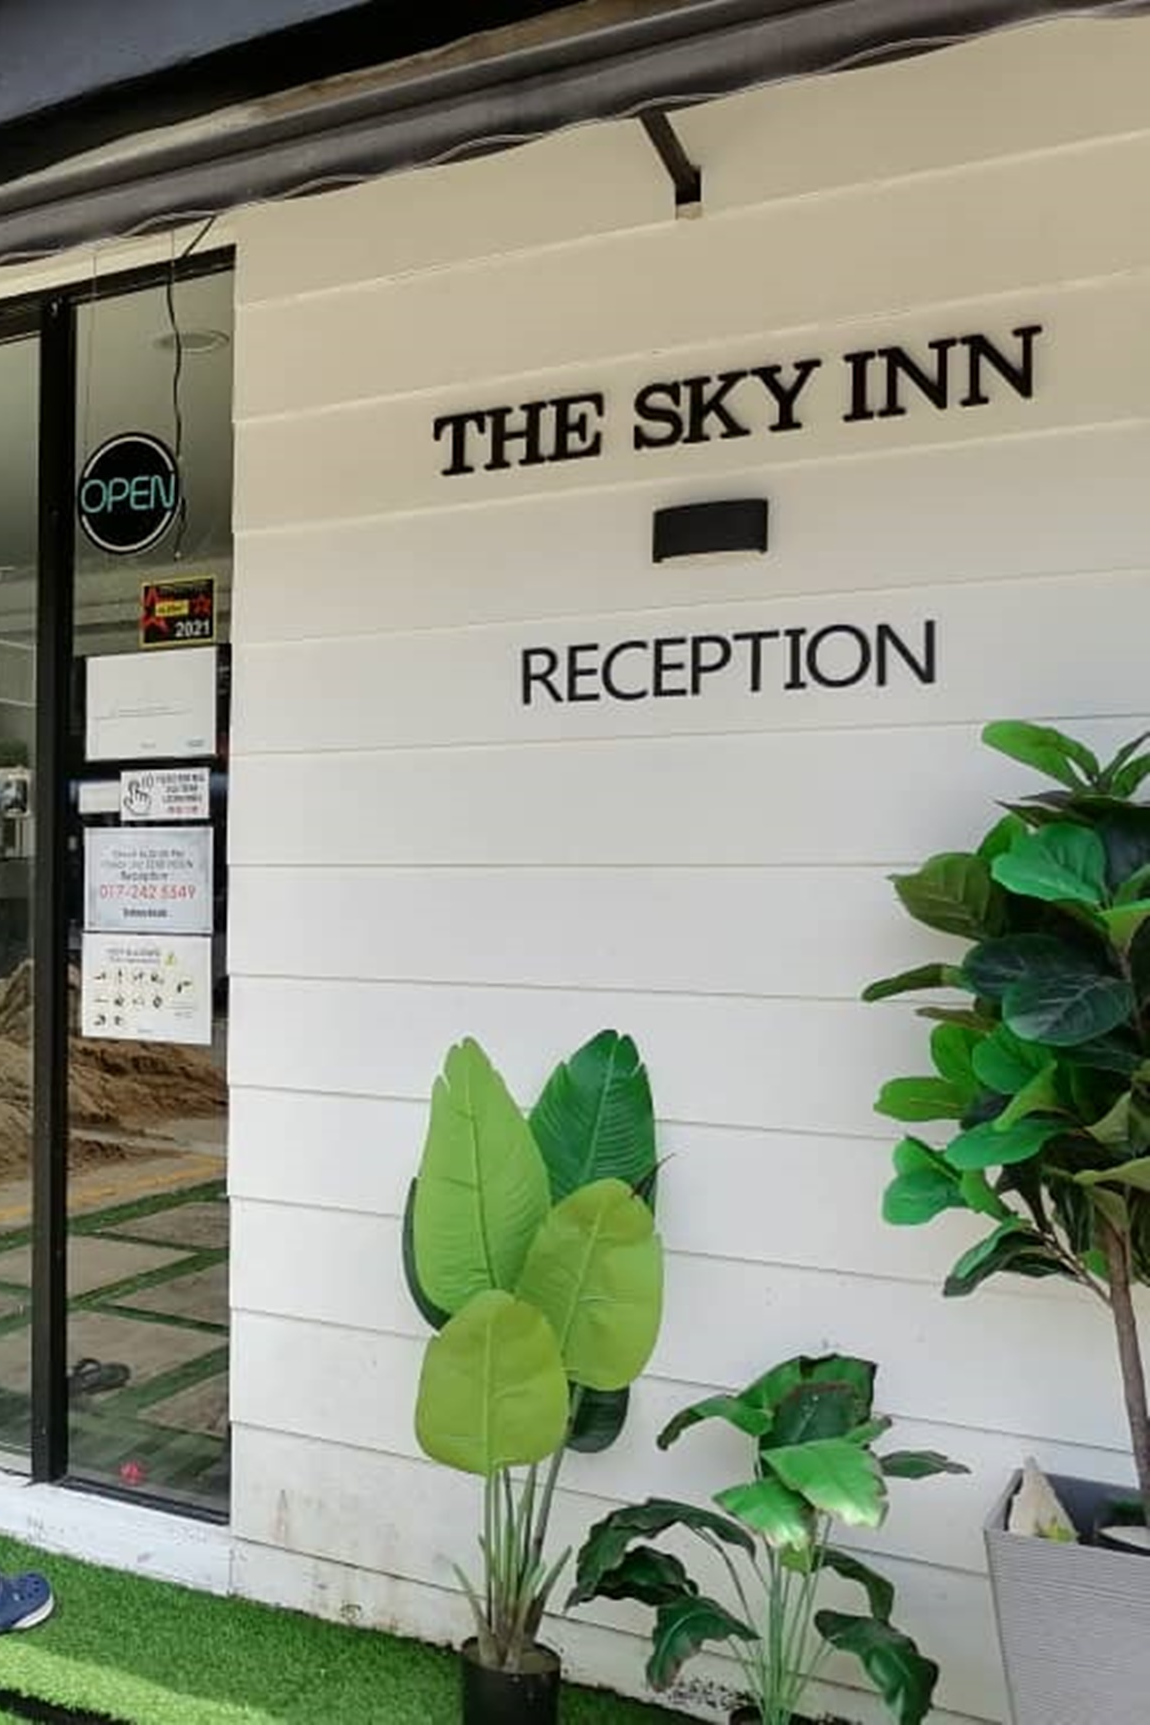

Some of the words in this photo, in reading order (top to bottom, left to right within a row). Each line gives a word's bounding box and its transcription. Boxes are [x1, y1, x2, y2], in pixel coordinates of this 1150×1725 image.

[433, 392, 604, 476] THE
[633, 359, 822, 450] SKY
[843, 325, 1042, 422] INN
[81, 474, 175, 513] OPEN
[176, 619, 211, 638] 2021
[521, 619, 937, 704] RECEPTION
